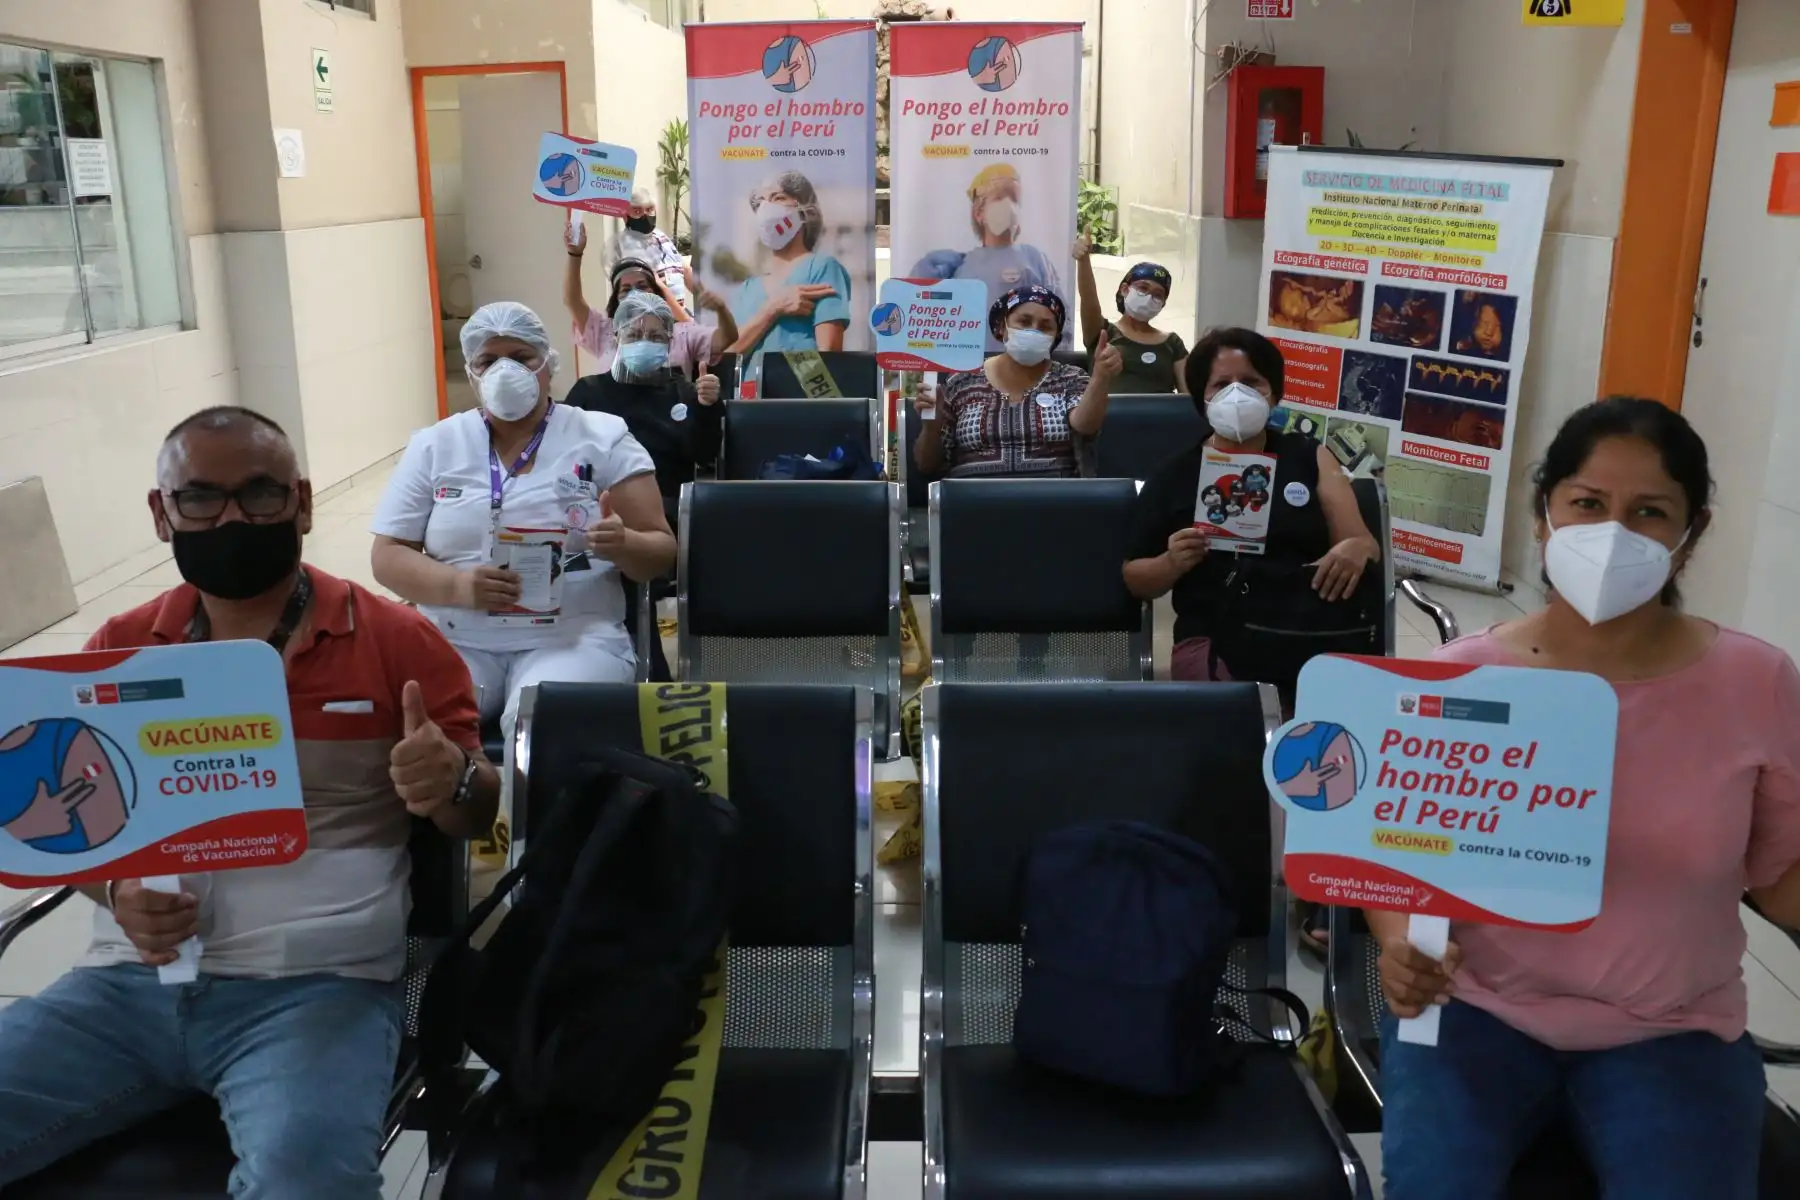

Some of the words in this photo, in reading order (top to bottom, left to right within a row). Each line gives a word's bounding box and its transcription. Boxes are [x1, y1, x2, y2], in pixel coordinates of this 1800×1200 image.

[699, 101, 758, 122] Pongo
[764, 99, 782, 116] el
[788, 98, 865, 116] hombro
[902, 100, 962, 120] Pongo
[968, 98, 987, 115] el
[992, 98, 1069, 116] hombro
[727, 123, 761, 143] por
[767, 120, 785, 137] el
[790, 119, 836, 137] Perú
[931, 122, 966, 141] por
[971, 119, 989, 136] el
[994, 118, 1039, 136] Perú
[770, 149, 797, 157] contra
[799, 148, 806, 157] la
[808, 148, 846, 157] COVID-19
[1002, 147, 1010, 155] la
[1011, 147, 1049, 156] COVID-19
[590, 180, 627, 193] COVID-19
[1306, 171, 1362, 188] SERVICIO
[1367, 176, 1382, 189] DE
[1389, 177, 1455, 194] MEDICINA
[1461, 182, 1504, 198] FETAL
[1324, 192, 1360, 204] Instituto
[1362, 196, 1399, 207] Nacional
[1401, 199, 1439, 210] Materno
[1441, 201, 1482, 213] Perinatal
[1311, 207, 1350, 218] Predicción,
[1446, 219, 1496, 231] seguimiento
[1315, 218, 1341, 227] manejo
[1343, 219, 1353, 227] de
[1354, 221, 1411, 233] complicaciones
[1413, 226, 1439, 236] fetales
[1442, 229, 1456, 238] y/o
[1459, 231, 1496, 241] maternas
[1352, 230, 1385, 241] Docencia
[1277, 252, 1321, 267] Ecografía
[1324, 257, 1366, 271] genética
[1320, 240, 1332, 250] 2D
[1342, 242, 1354, 252] 3D
[1364, 244, 1377, 255] 4D
[1387, 247, 1423, 260] Doppler
[1434, 253, 1482, 266] Monitoreo
[1385, 264, 1434, 279] Ecografía
[1437, 271, 1504, 288] morfológica
[908, 304, 947, 317] Pongo
[950, 305, 962, 316] el
[907, 329, 918, 338] el
[922, 329, 950, 340] Perú
[908, 316, 956, 329] hombro
[959, 320, 981, 331] por
[1404, 443, 1457, 462] Monitoreo
[1460, 454, 1487, 467] Fetal
[1408, 535, 1461, 553] Amniocentesis
[147, 721, 273, 748] VACÚNATE
[1379, 728, 1490, 770] Pongo
[1502, 741, 1537, 769] el
[174, 755, 236, 773] Contra
[240, 753, 256, 768] la
[159, 770, 277, 796] COVID-19
[1376, 761, 1519, 802] hombro
[1527, 784, 1597, 812] por
[1374, 797, 1406, 823] el
[1415, 799, 1502, 834] Perú
[160, 838, 221, 857] Campaña
[223, 834, 278, 849] Nacional
[183, 852, 199, 863] de
[200, 844, 276, 862] Vacunación
[1375, 831, 1450, 852] VACÚNATE
[1459, 842, 1505, 857] contra
[1508, 845, 1521, 859] la
[1525, 848, 1591, 868] COVID-19
[1309, 873, 1362, 890] Campaña
[1365, 880, 1414, 896] Nacional
[1325, 886, 1340, 897] de
[1343, 888, 1410, 906] Vacunación
